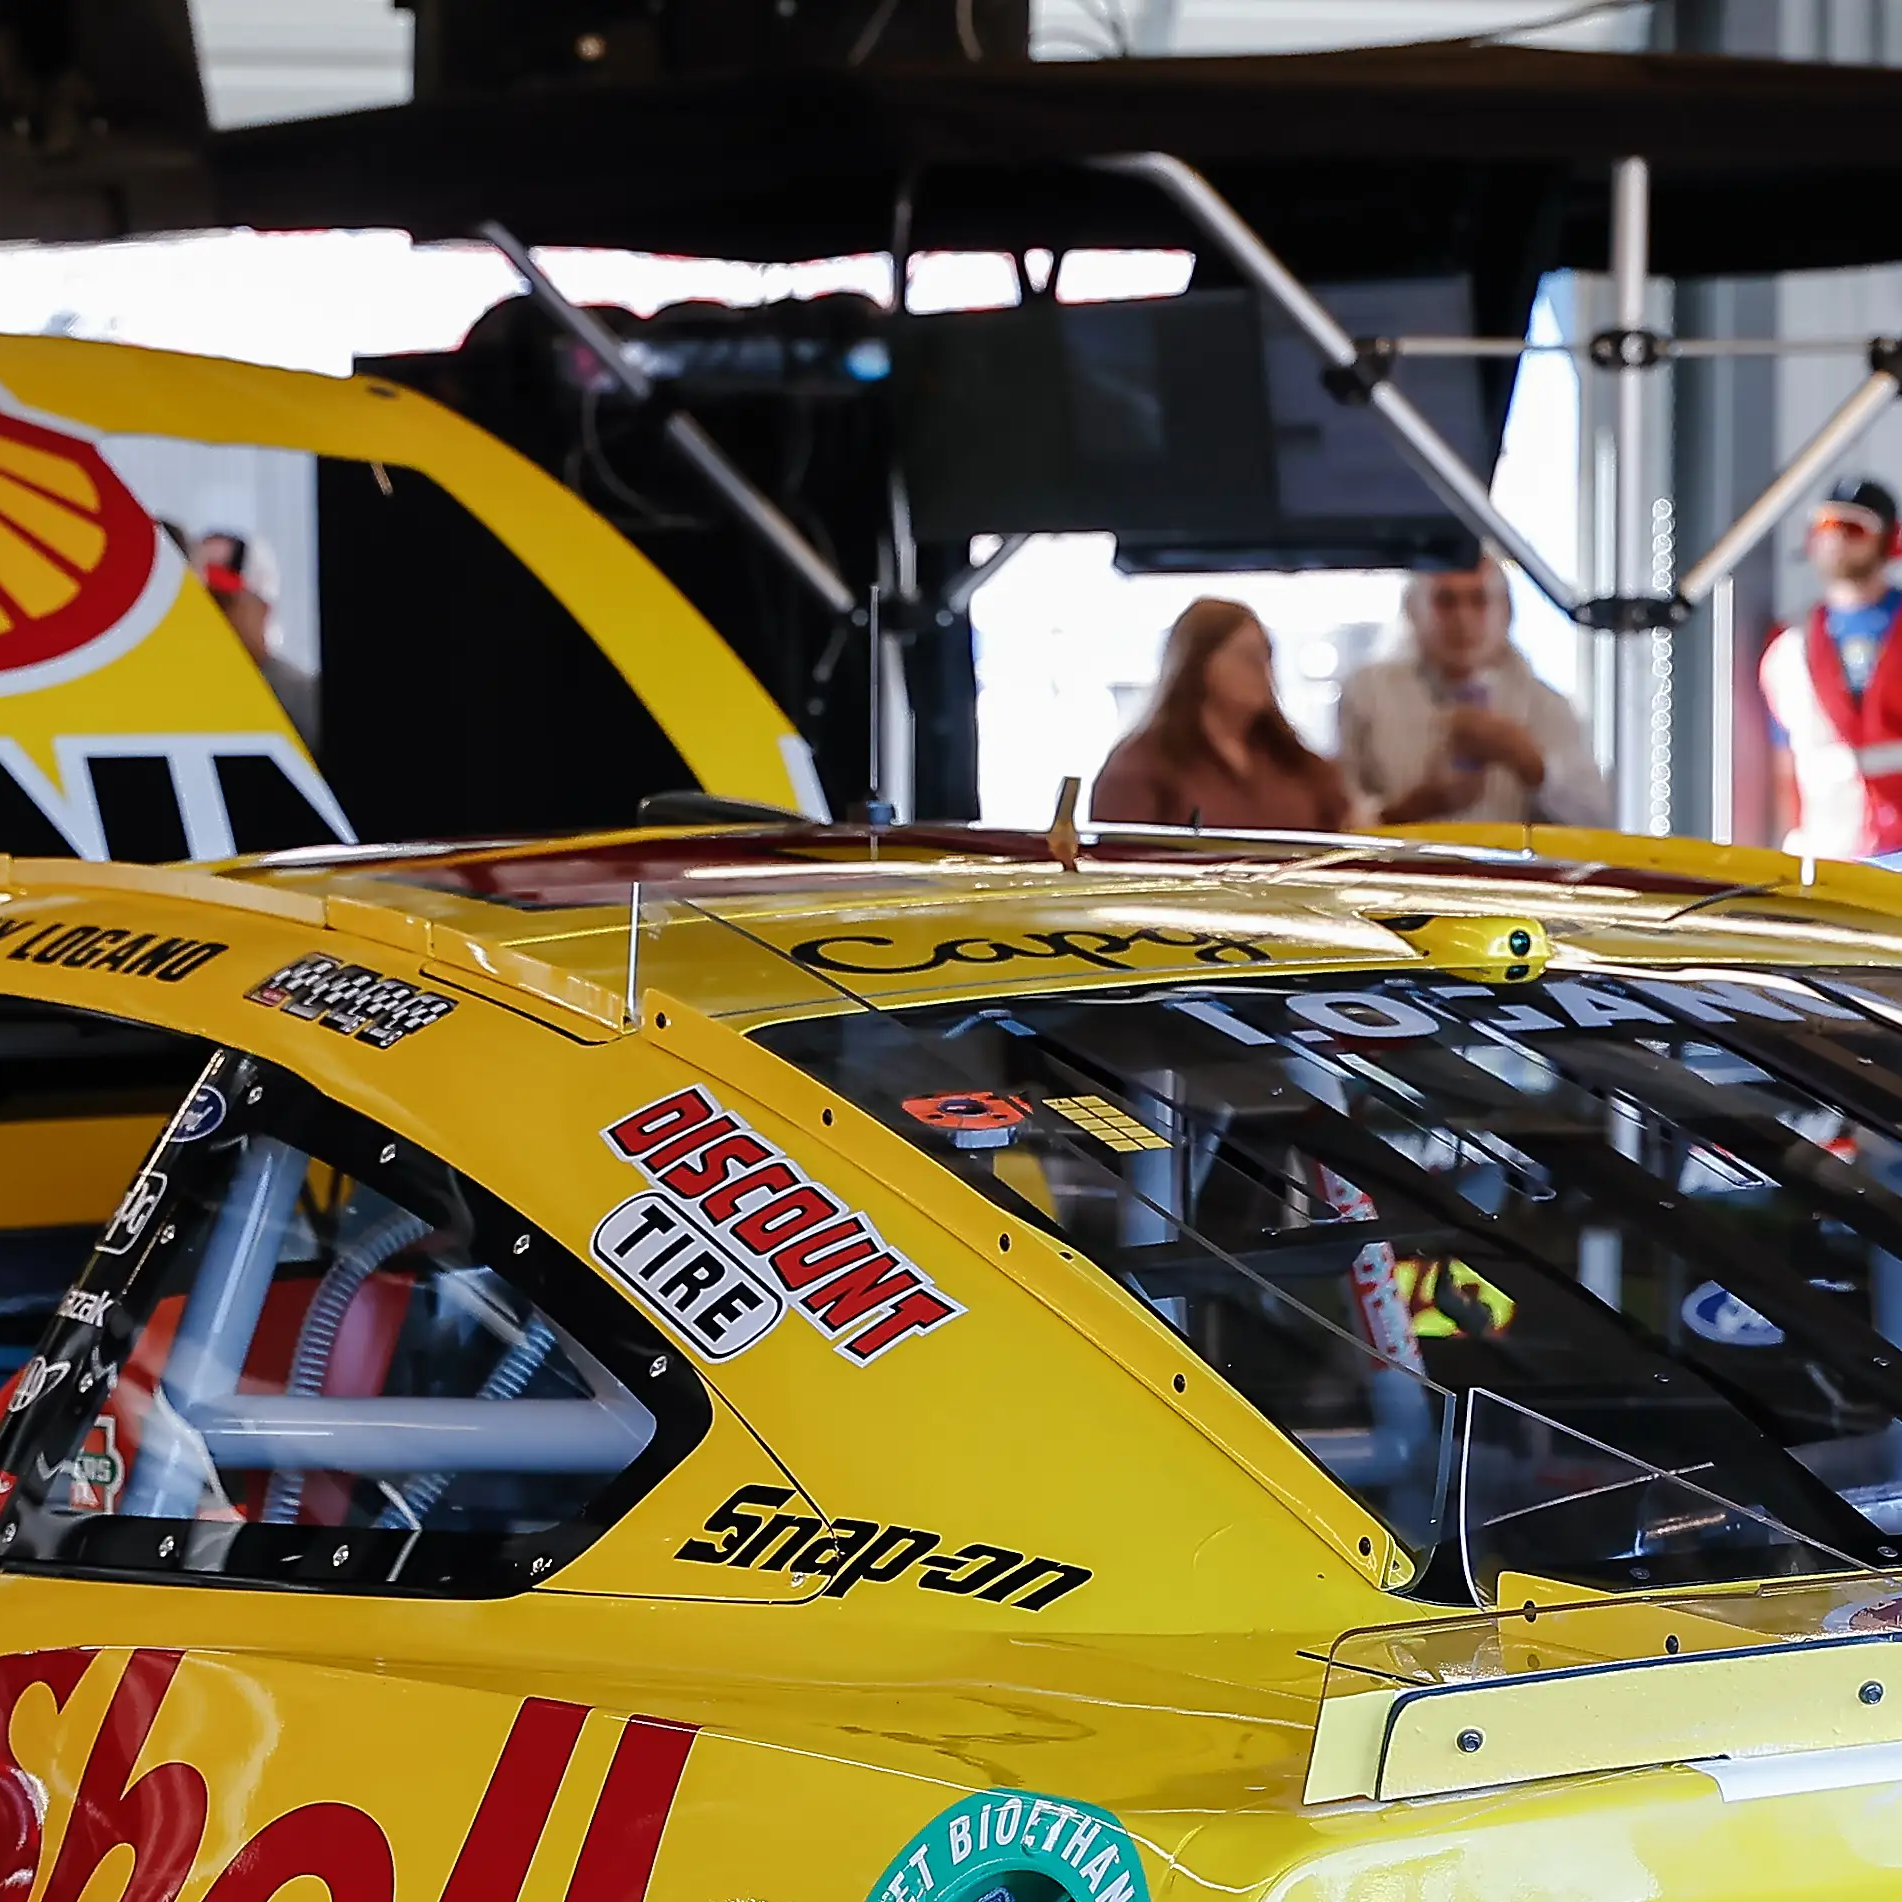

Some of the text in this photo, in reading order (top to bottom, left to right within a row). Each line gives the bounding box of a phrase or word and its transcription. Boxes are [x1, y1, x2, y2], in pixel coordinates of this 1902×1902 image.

[5, 923, 230, 983] LOGANO
[605, 1086, 956, 1362] DISCOUNT
[613, 1203, 771, 1344] TIRE
[673, 1483, 1093, 1613] Snap-on
